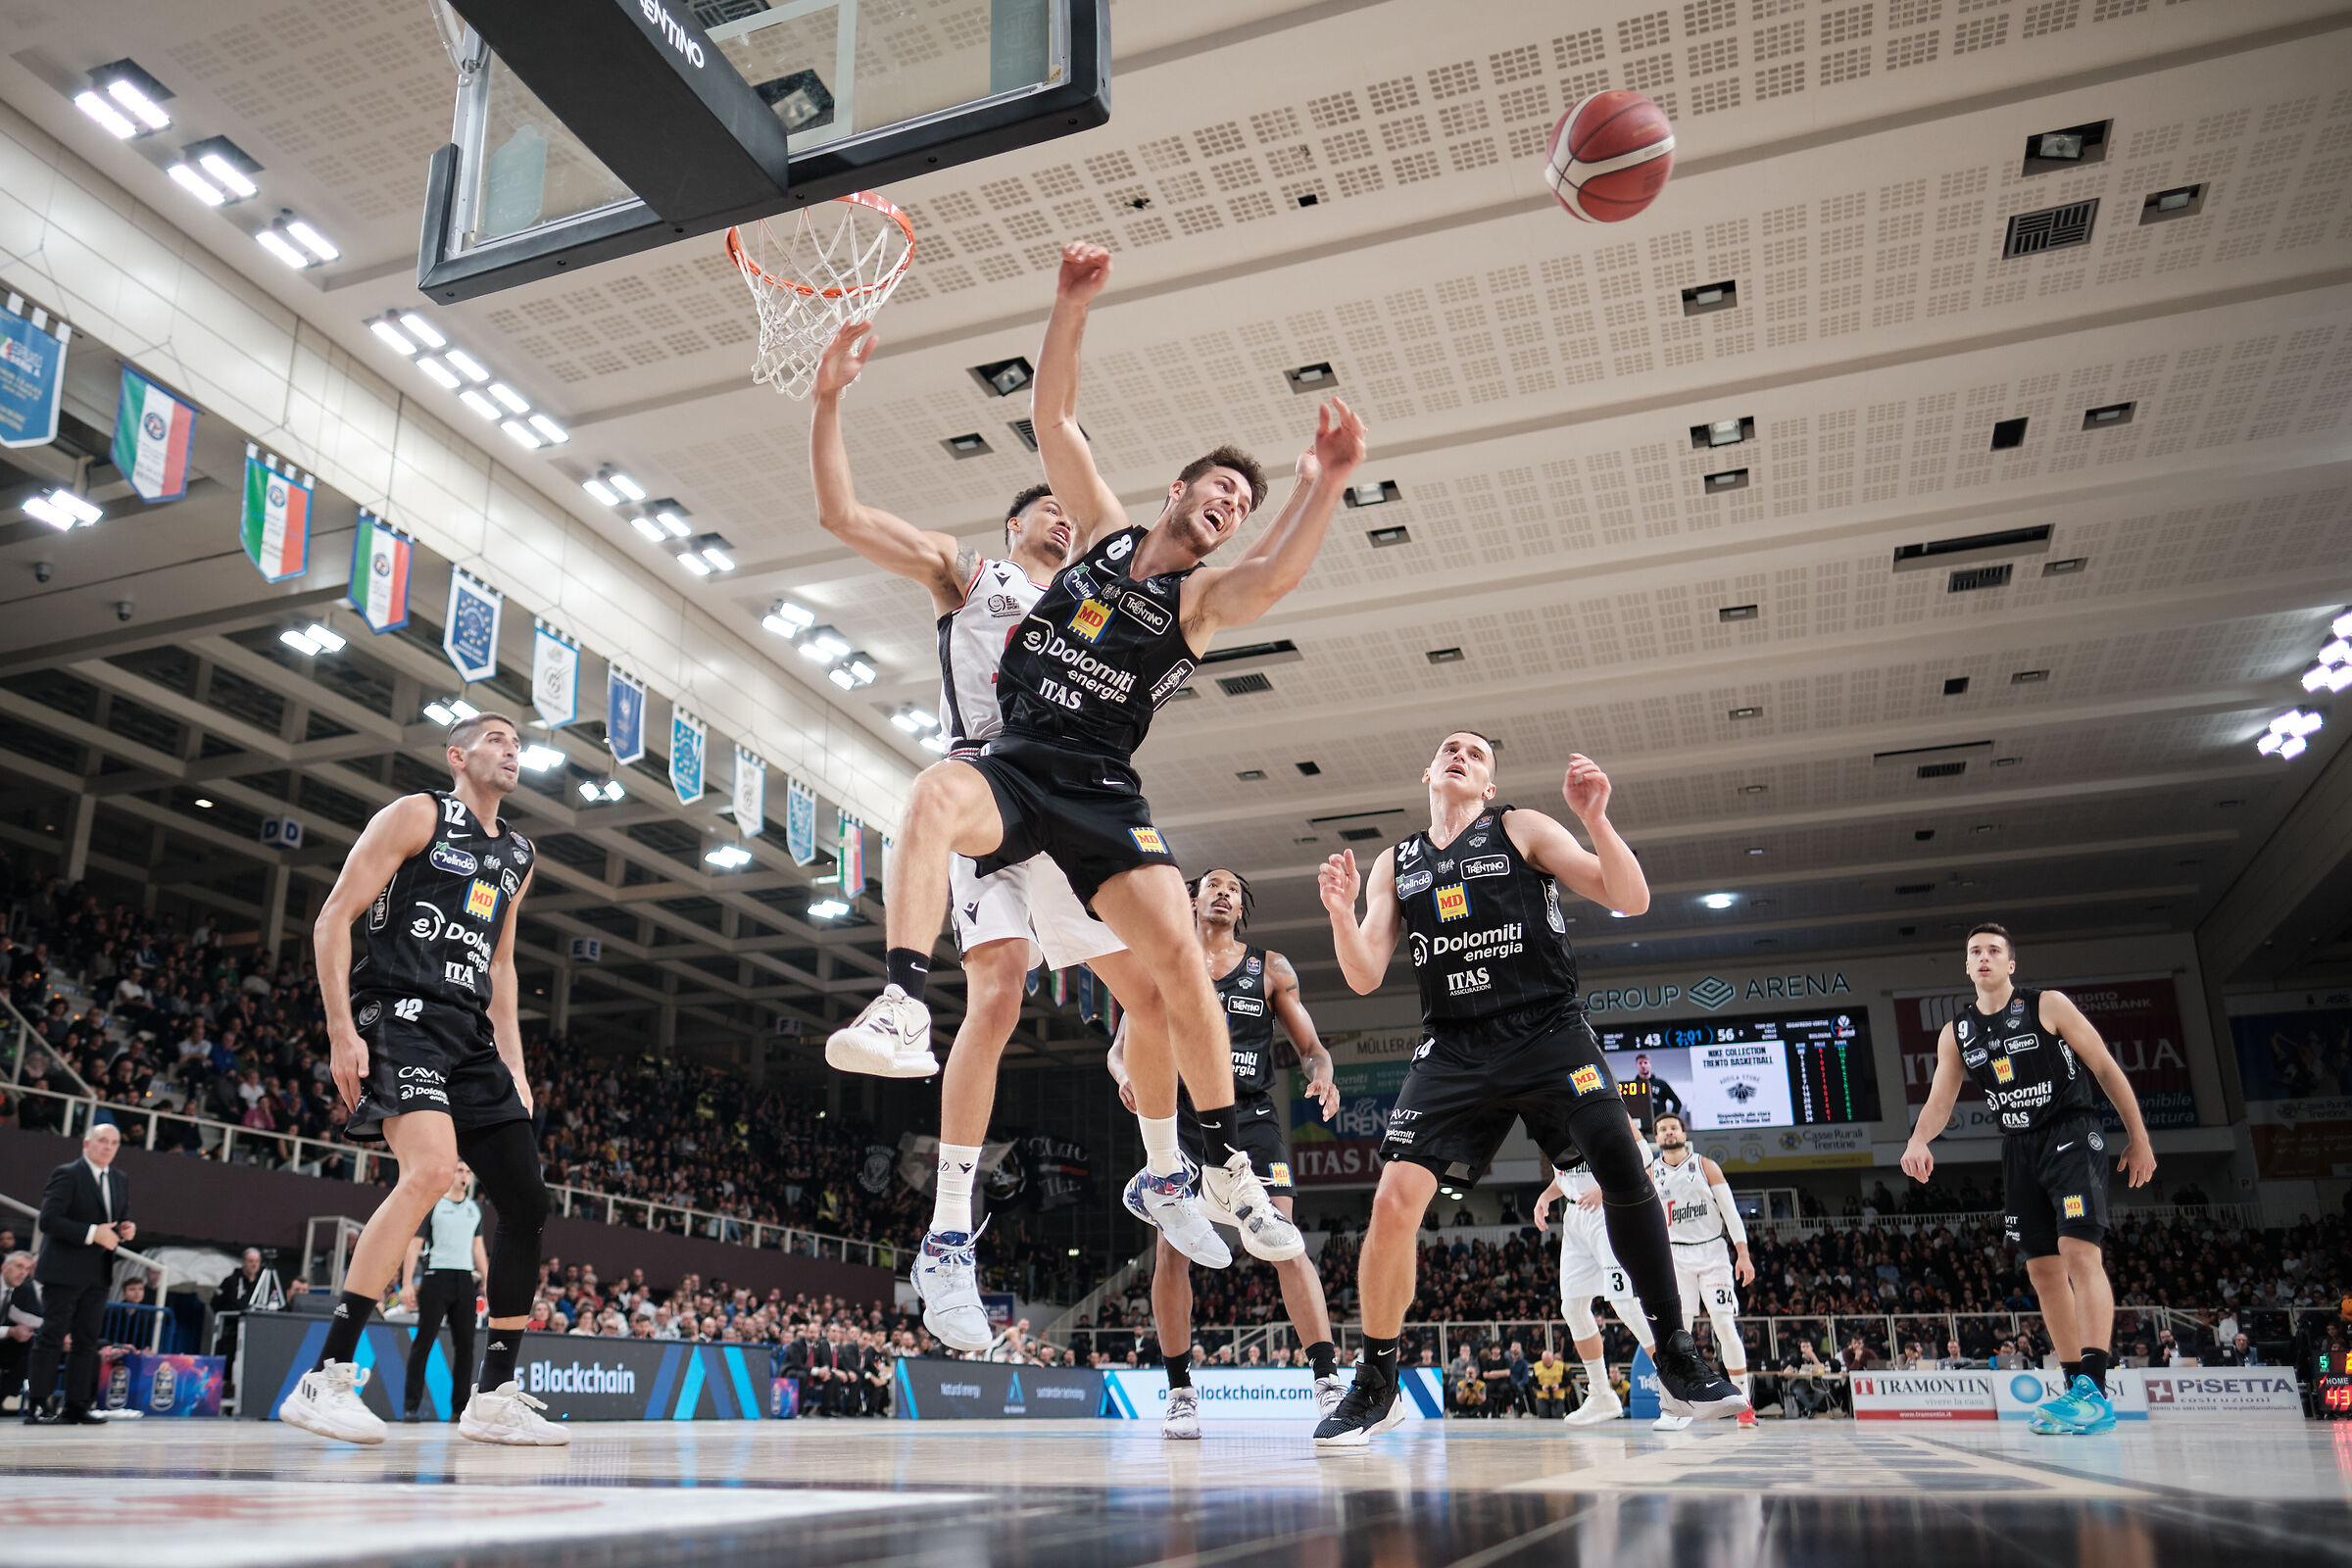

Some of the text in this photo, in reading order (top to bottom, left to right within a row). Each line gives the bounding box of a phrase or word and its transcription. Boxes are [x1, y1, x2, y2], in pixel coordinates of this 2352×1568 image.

[1106, 534, 1133, 560] 8
[1078, 606, 1103, 627] MD
[1127, 597, 1163, 625] TRENTINO
[1048, 637, 1137, 693] Dolomiti
[1067, 669, 1127, 704] energia
[1152, 666, 1188, 703] TRENTIN
[1039, 677, 1082, 710] ITAS
[442, 799, 466, 826] 12
[285, 822, 298, 841] D
[1138, 834, 1158, 845] MD
[1397, 838, 1420, 862] 24
[1466, 860, 1504, 874] TRENTINO
[373, 888, 388, 923] TRENTI
[471, 890, 493, 908] MD
[1440, 894, 1463, 910] MD
[1434, 923, 1522, 956] Dolomiti
[1464, 942, 1523, 963] energia
[445, 961, 475, 984] ITA
[1447, 967, 1490, 991] ITAS
[1587, 972, 1851, 1012] GROUP ARENA
[2074, 991, 2118, 1004] REDITO
[394, 999, 423, 1022] 12
[2079, 997, 2153, 1012] ONSBANK
[1675, 1030, 1702, 1042] 2:01
[1717, 1028, 1735, 1042] 56
[1958, 1020, 1968, 1039] 9
[1644, 1034, 1661, 1047] 43
[1231, 1051, 1258, 1065] miti
[1726, 1047, 1766, 1056] COLLECTION
[1731, 1056, 1773, 1066] BASKETBALL
[1903, 1053, 1936, 1085] IT
[1995, 1063, 2010, 1076] MD
[1231, 1064, 1256, 1076] ergia
[1575, 1071, 1597, 1086] MD
[416, 1087, 448, 1100] Dolom
[1336, 1103, 1390, 1137] TREN
[1390, 1108, 1423, 1121] AVIT
[1387, 1129, 1415, 1139] olomiti
[1802, 1128, 1863, 1142] Casse Rurali
[1813, 1140, 1856, 1151] Trentine
[1298, 1148, 1361, 1176] ITAS
[1275, 1169, 1288, 1179] MD
[2066, 1201, 2081, 1210] MD
[2005, 1215, 2018, 1224] VIT
[1612, 1273, 1625, 1292] 3
[1716, 1289, 1733, 1305] 34
[530, 1360, 636, 1394] Blockchain
[1877, 1377, 1989, 1395] TRAMONTIN
[2177, 1379, 2294, 1393] PiSETTA
[2328, 1390, 2350, 1405] 43
